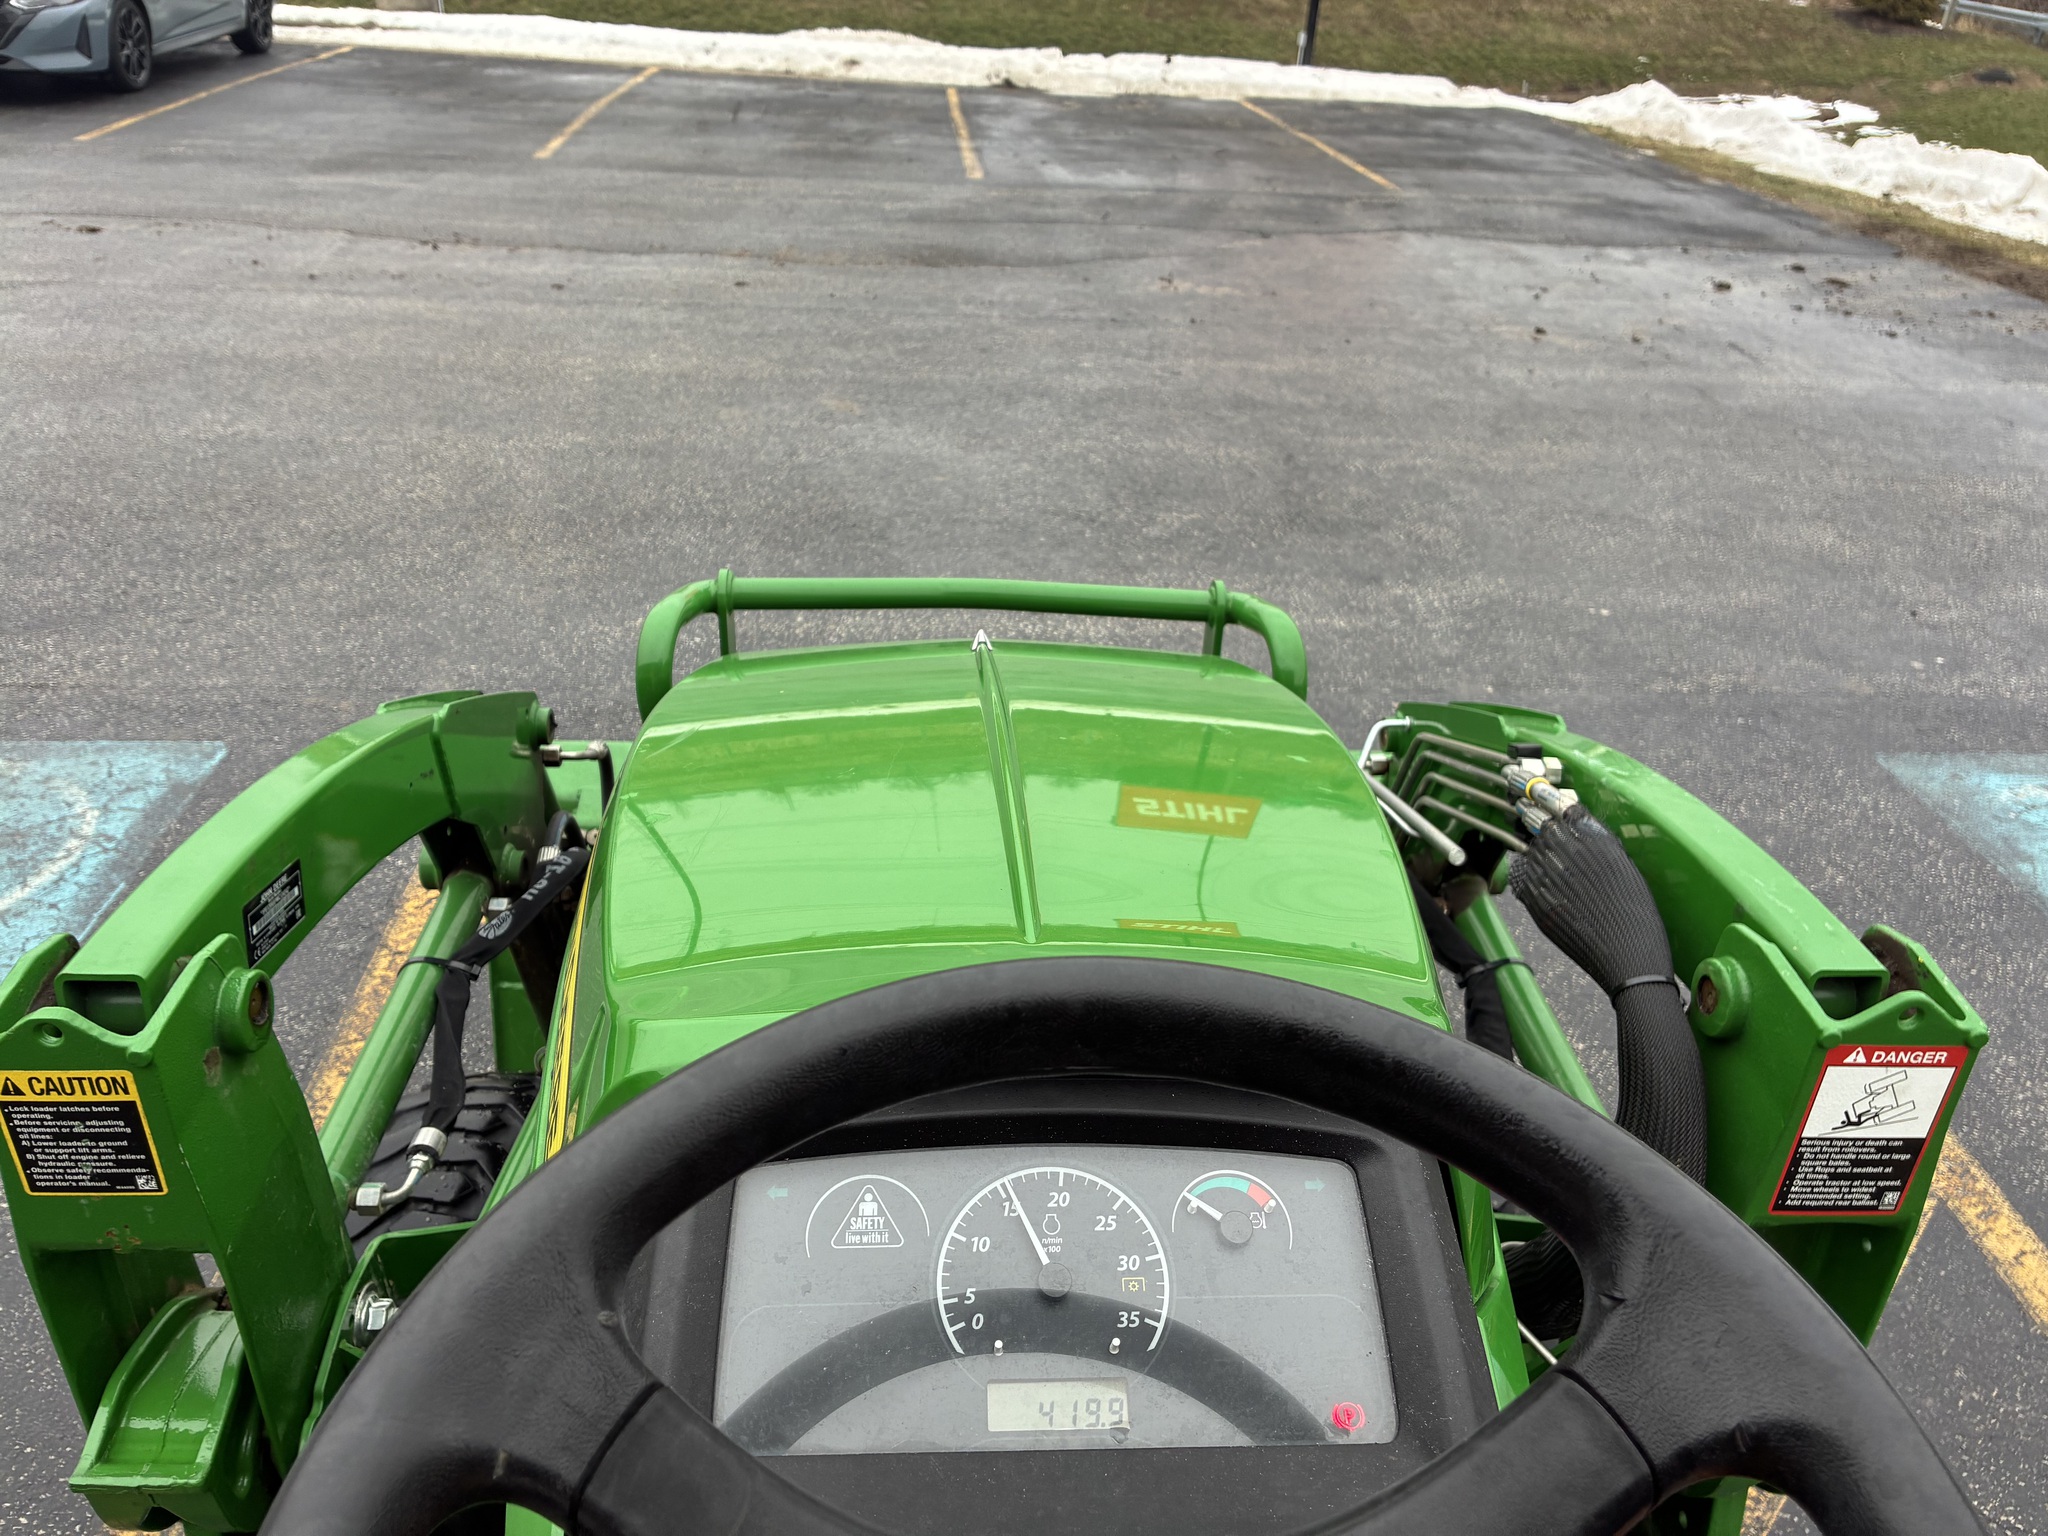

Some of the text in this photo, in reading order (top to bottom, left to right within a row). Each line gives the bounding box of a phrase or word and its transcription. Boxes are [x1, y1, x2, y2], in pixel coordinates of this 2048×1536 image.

[1130, 922, 1232, 934] STIHL
[1871, 1051, 1948, 1064] DANGER
[27, 1076, 130, 1096] CAUTION
[1891, 1153, 1911, 1161] large
[1876, 1179, 1901, 1187] speed.
[1047, 1192, 1070, 1207] 20
[1801, 1199, 1835, 1207] required
[1843, 1192, 1871, 1200] setting.
[1002, 1201, 1021, 1217] 15
[850, 1216, 885, 1230] SAFETY
[1094, 1215, 1117, 1231] 25
[845, 1232, 889, 1244] live with it
[970, 1236, 990, 1252] 10
[1042, 1237, 1063, 1245] n/min
[1117, 1255, 1140, 1271] 30
[963, 1288, 977, 1304] 5
[971, 1313, 984, 1330] 0
[1116, 1311, 1141, 1328] 35
[1038, 1396, 1124, 1429] 419.9
